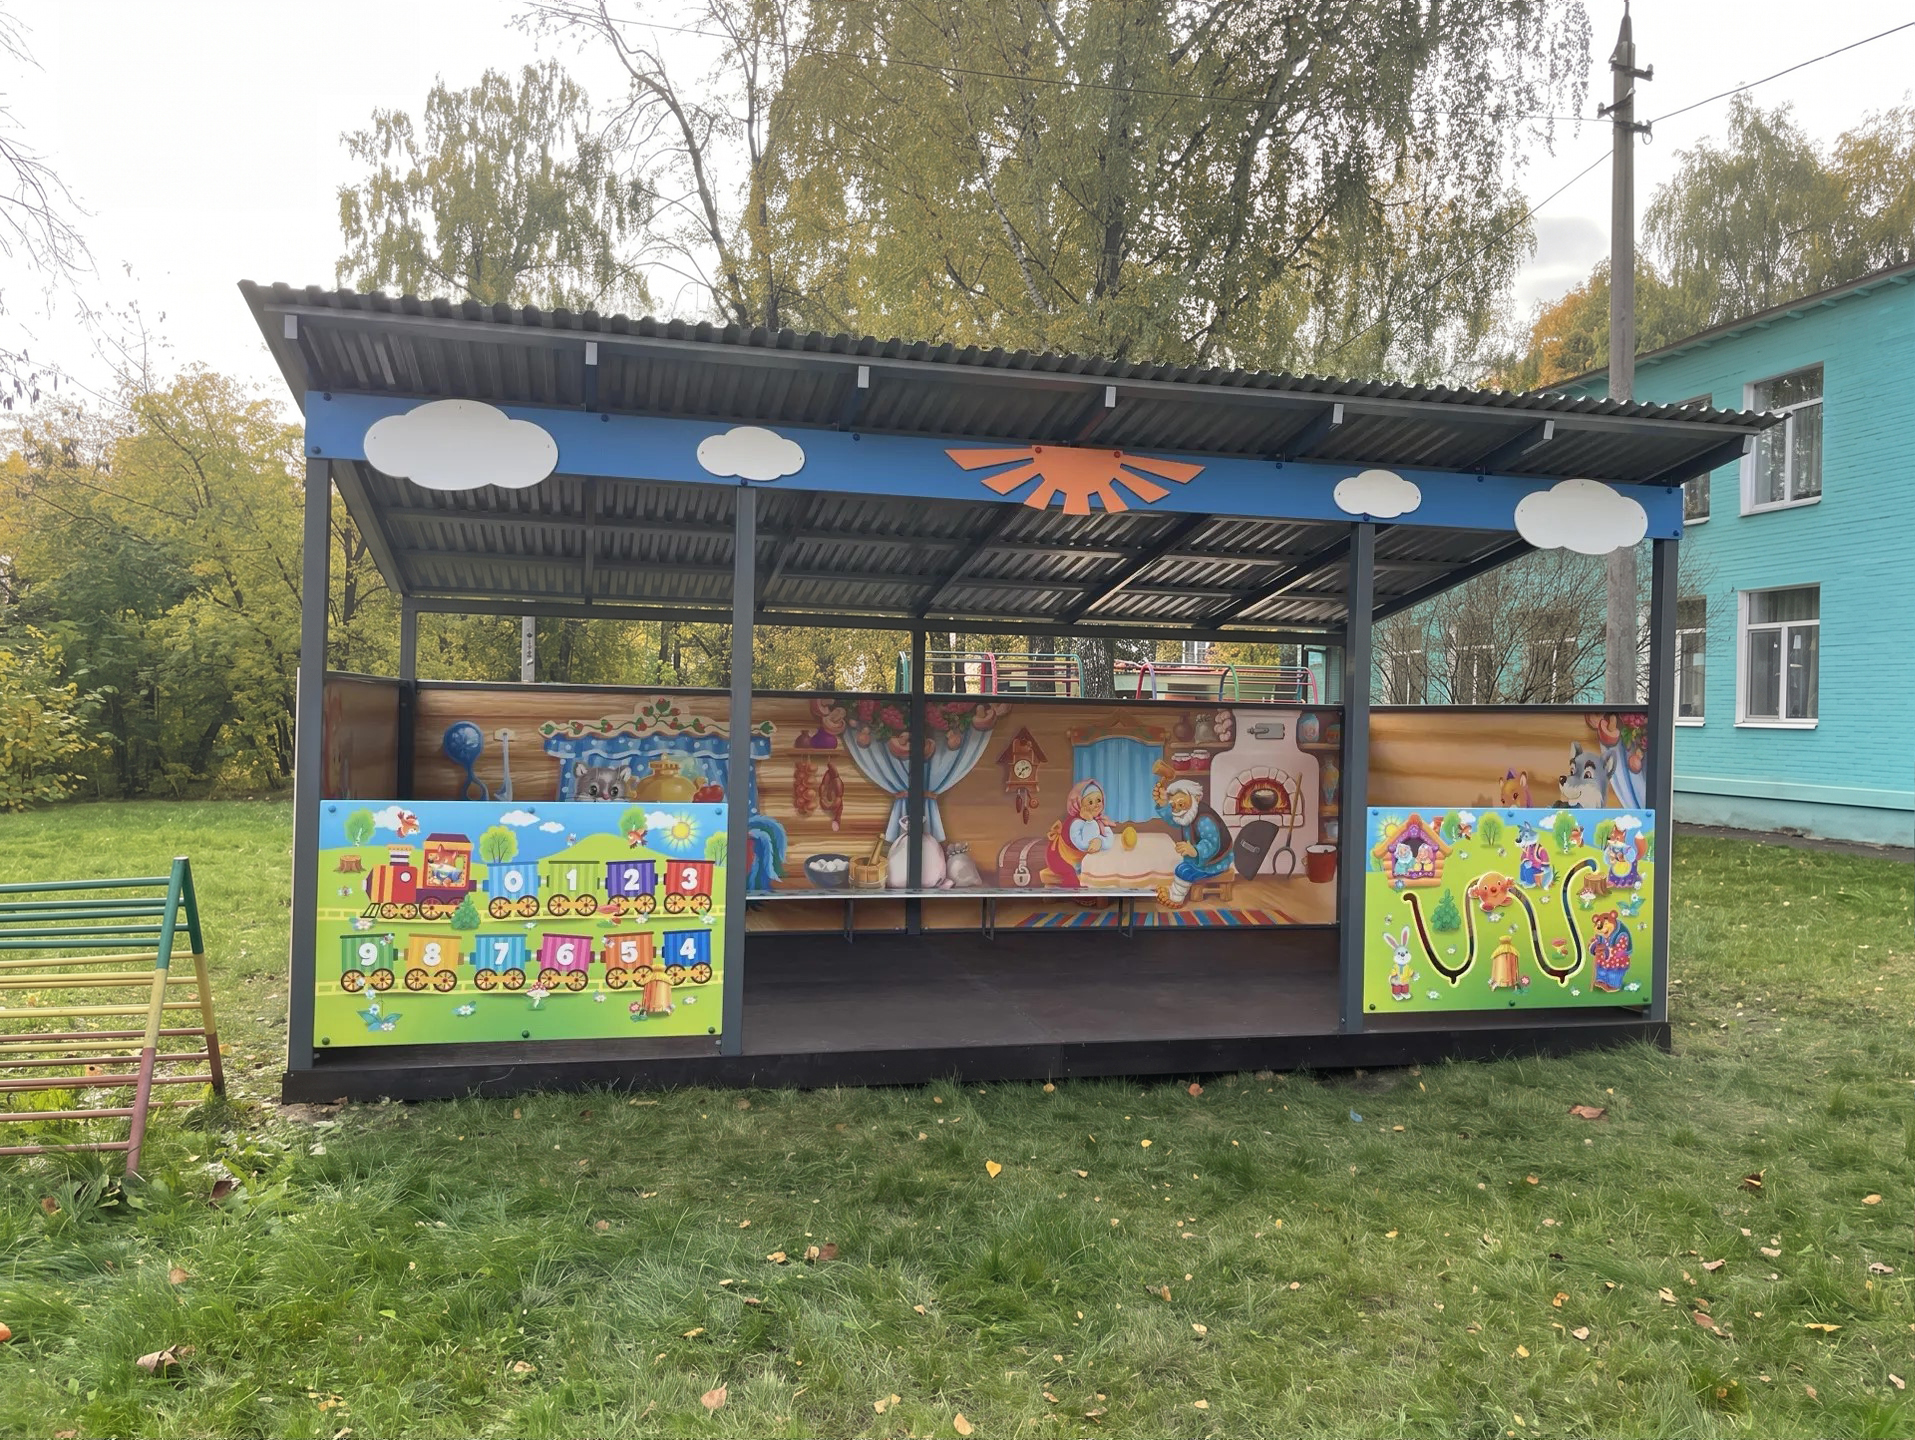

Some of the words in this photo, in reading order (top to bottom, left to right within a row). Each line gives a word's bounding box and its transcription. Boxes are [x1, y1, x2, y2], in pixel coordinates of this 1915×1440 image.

[504, 870, 523, 892] 0
[566, 868, 577, 891] 1
[624, 868, 640, 891] 2
[681, 867, 698, 890] 3
[358, 942, 378, 966] 9
[423, 943, 441, 966] 8
[494, 943, 509, 965] 7
[556, 943, 574, 966] 6
[620, 941, 639, 963] 5
[679, 938, 697, 959] 4
